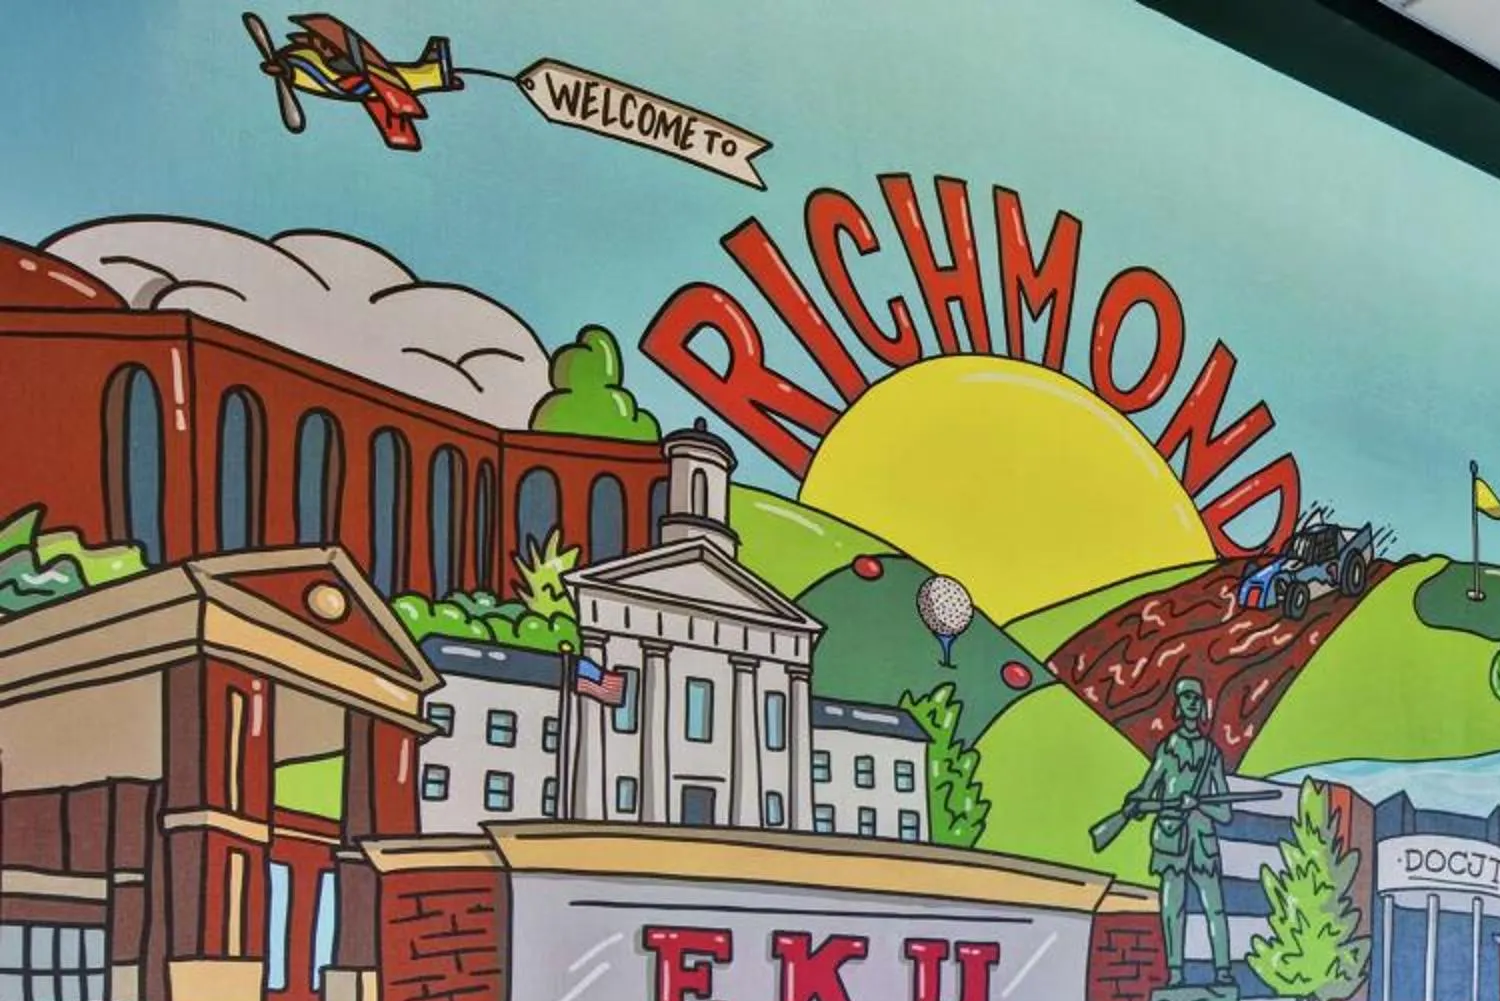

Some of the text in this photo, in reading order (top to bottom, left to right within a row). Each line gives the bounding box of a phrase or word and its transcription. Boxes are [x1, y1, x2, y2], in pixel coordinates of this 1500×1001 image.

[545, 71, 738, 157] WELCOME TO
[638, 172, 1301, 561] RICHMOND
